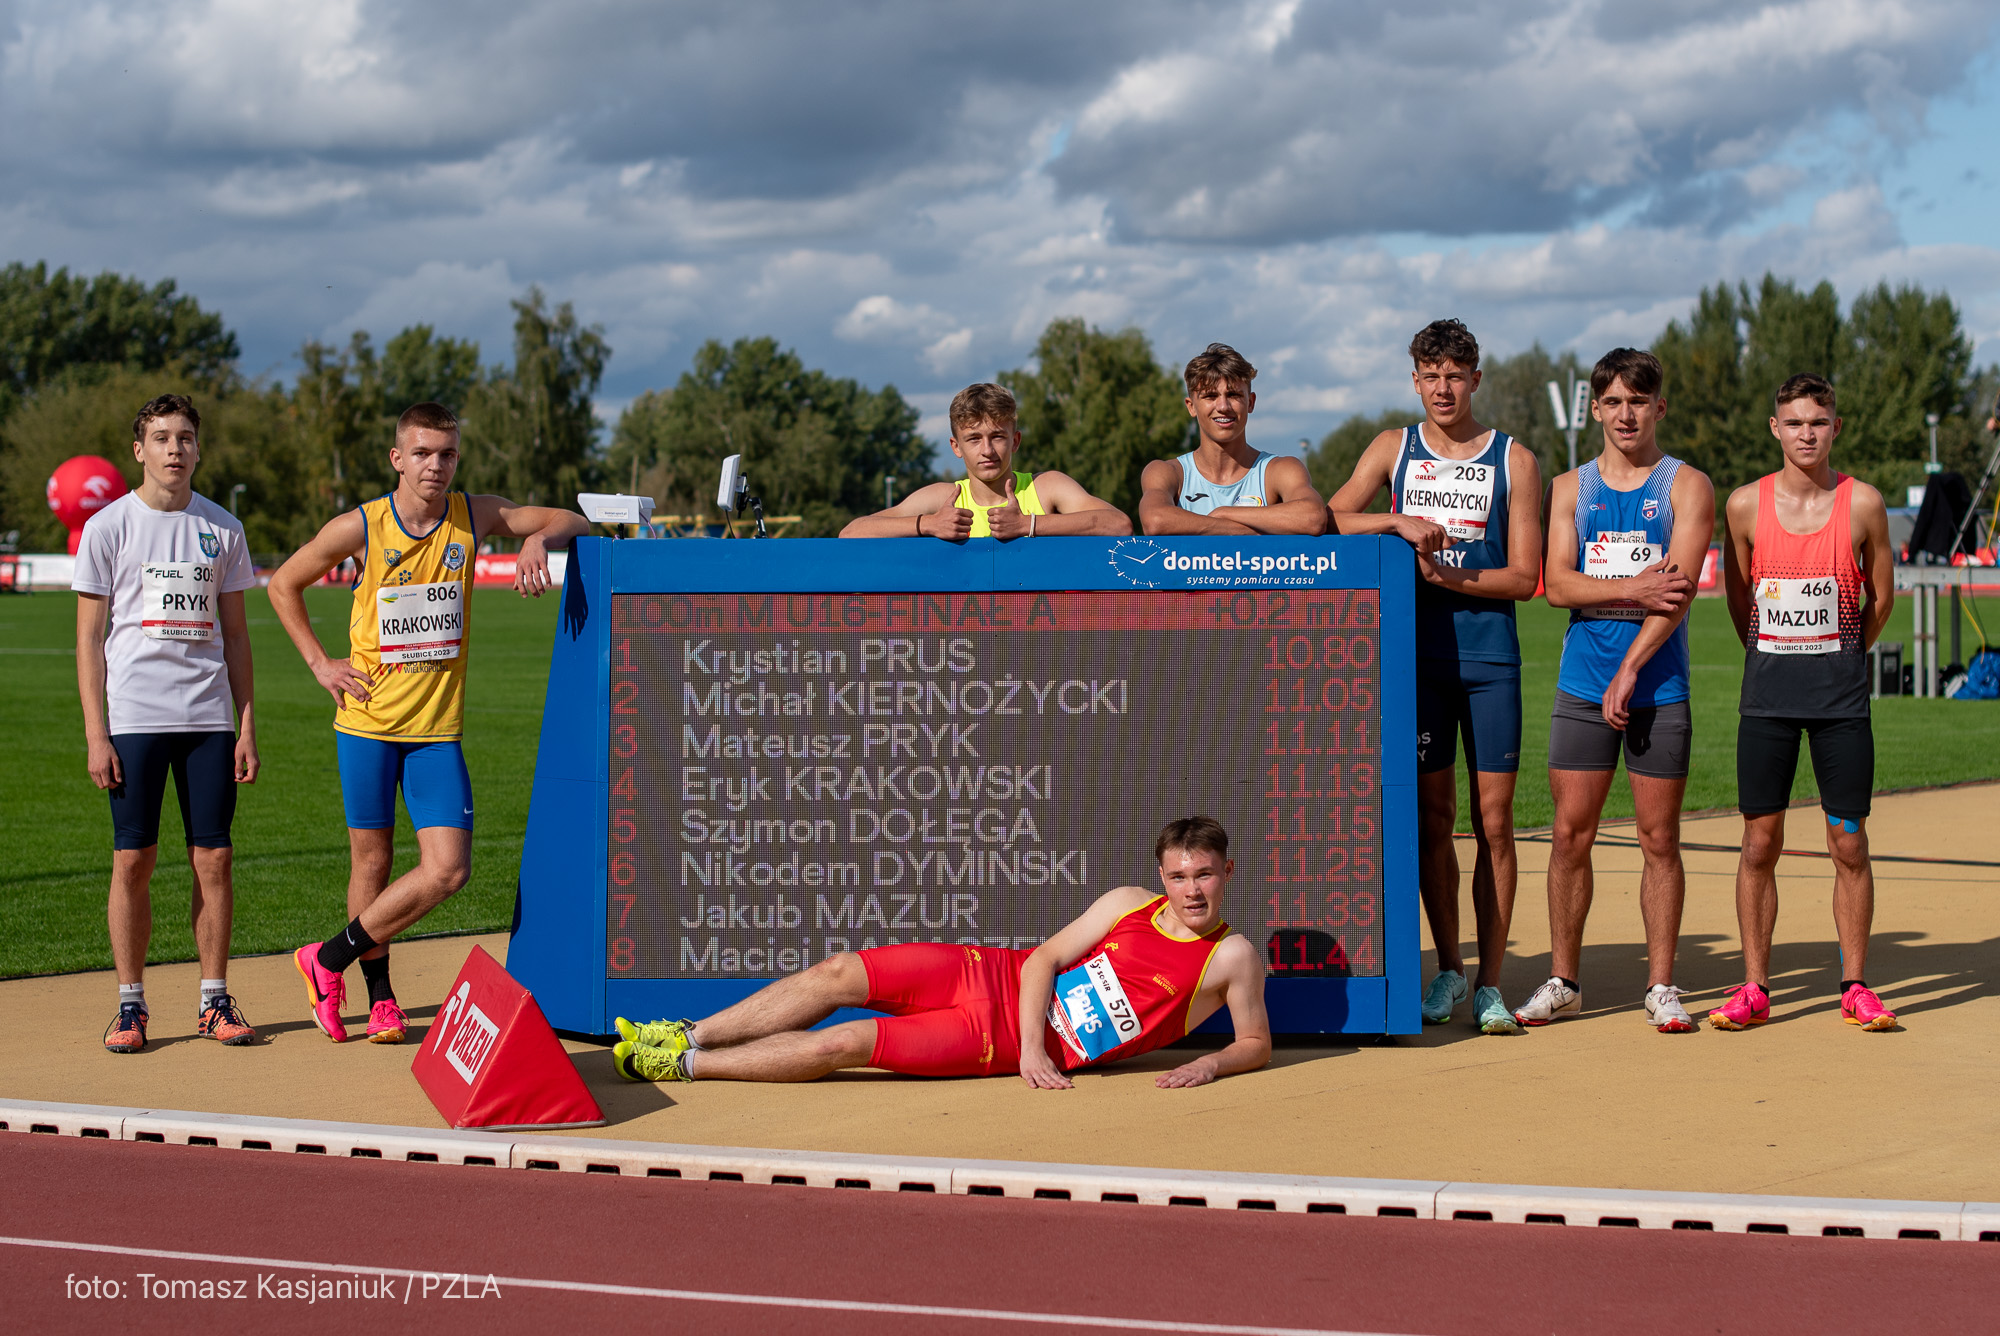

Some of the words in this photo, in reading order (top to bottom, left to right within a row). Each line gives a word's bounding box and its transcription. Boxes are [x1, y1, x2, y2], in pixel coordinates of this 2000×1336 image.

[1454, 466, 1486, 481] 203
[1406, 489, 1488, 511] KIERNOŻYCKI
[1449, 527, 1467, 535] 2023
[1163, 551, 1337, 574] domtel-sport.pl
[1631, 547, 1651, 561] 69
[155, 570, 184, 579] FUEL
[1187, 576, 1231, 585] systemy
[1234, 576, 1280, 586] pomiaru
[1284, 576, 1315, 585] czasu
[427, 585, 457, 601] 806
[1801, 581, 1832, 597] 466
[163, 593, 209, 612] PRYK
[618, 597, 723, 629] 100m
[738, 595, 773, 628] M
[1027, 594, 1057, 627] A
[1208, 591, 1290, 626] +0.2
[1306, 591, 1374, 626] m/s
[382, 612, 462, 635] KRAKOWSKI
[1768, 609, 1829, 626] MAZUR
[193, 629, 208, 637] 2023
[402, 651, 432, 659] SŁUBICE
[434, 649, 450, 657] 2023
[616, 639, 638, 672] 1
[684, 639, 846, 683] Krystian
[860, 638, 976, 672] PRUS
[1264, 636, 1375, 669] 10.80
[613, 682, 638, 714] 2
[683, 681, 816, 715] Michał
[828, 674, 1127, 716] KIERNOŻYCKI
[1265, 678, 1374, 712] 11.05
[614, 725, 638, 758] 3
[683, 725, 851, 757] Mateusz
[864, 723, 980, 757] PRYK
[1264, 721, 1374, 755] 11.11
[612, 768, 637, 801] 4
[682, 767, 772, 811] Eryk
[786, 766, 1051, 800] KRAKOWSKI
[1265, 763, 1374, 797] 11.13
[612, 810, 637, 843] 5
[681, 809, 835, 853] Szymon
[850, 808, 1042, 853] DOŁĘGA
[1265, 806, 1375, 841] 11.15
[611, 853, 637, 886] 6
[681, 851, 859, 886] Nikodem
[874, 843, 1087, 886] DYMIŃSKI
[1265, 847, 1376, 882] 11.25
[613, 895, 637, 928] 7
[680, 894, 800, 928] Jakub
[816, 894, 979, 928] MAZUR
[1266, 892, 1376, 927] 11.33
[610, 938, 635, 971] 8
[680, 937, 811, 971] Maciej
[1266, 935, 1376, 970] 11.44
[1109, 999, 1135, 1032] 570
[452, 1014, 493, 1074] ORLEN
